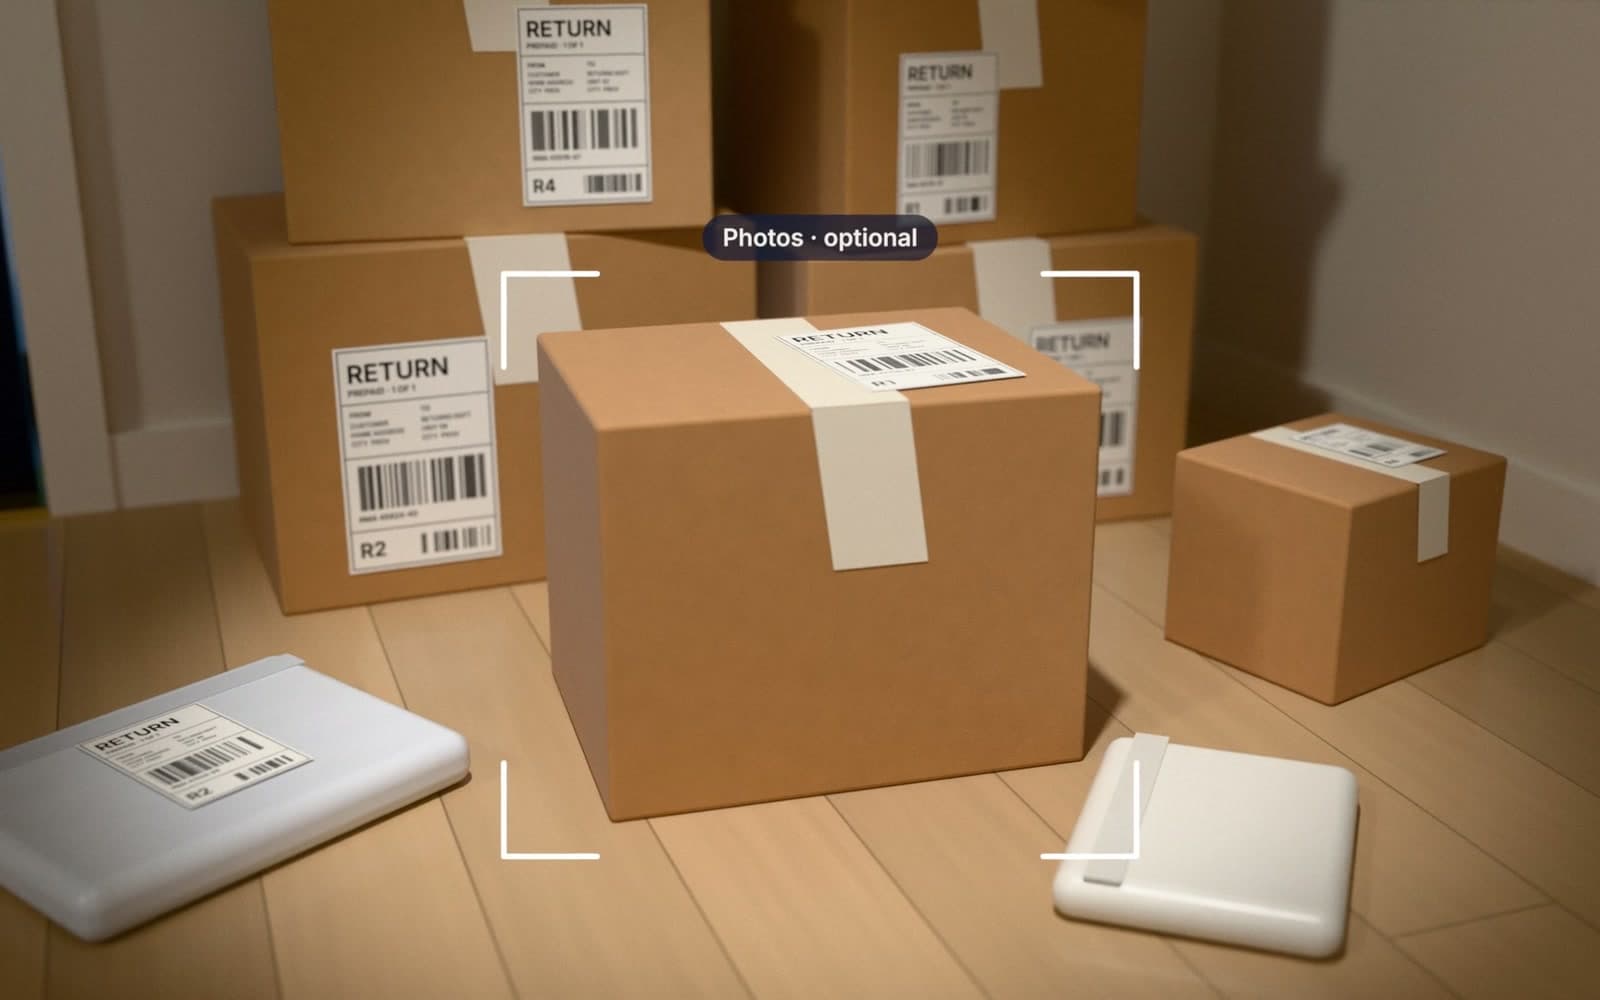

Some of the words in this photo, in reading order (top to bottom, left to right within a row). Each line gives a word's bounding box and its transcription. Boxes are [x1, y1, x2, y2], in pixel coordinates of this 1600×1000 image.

[526, 19, 611, 38] RETURN
[908, 64, 973, 81] RETURN
[532, 178, 556, 193] R4
[791, 329, 889, 343] RETURN
[1036, 332, 1111, 352] RETURN
[346, 356, 449, 385] RETURN
[360, 541, 387, 559] R2
[93, 717, 180, 751] RETURN
[185, 787, 213, 801] R2
